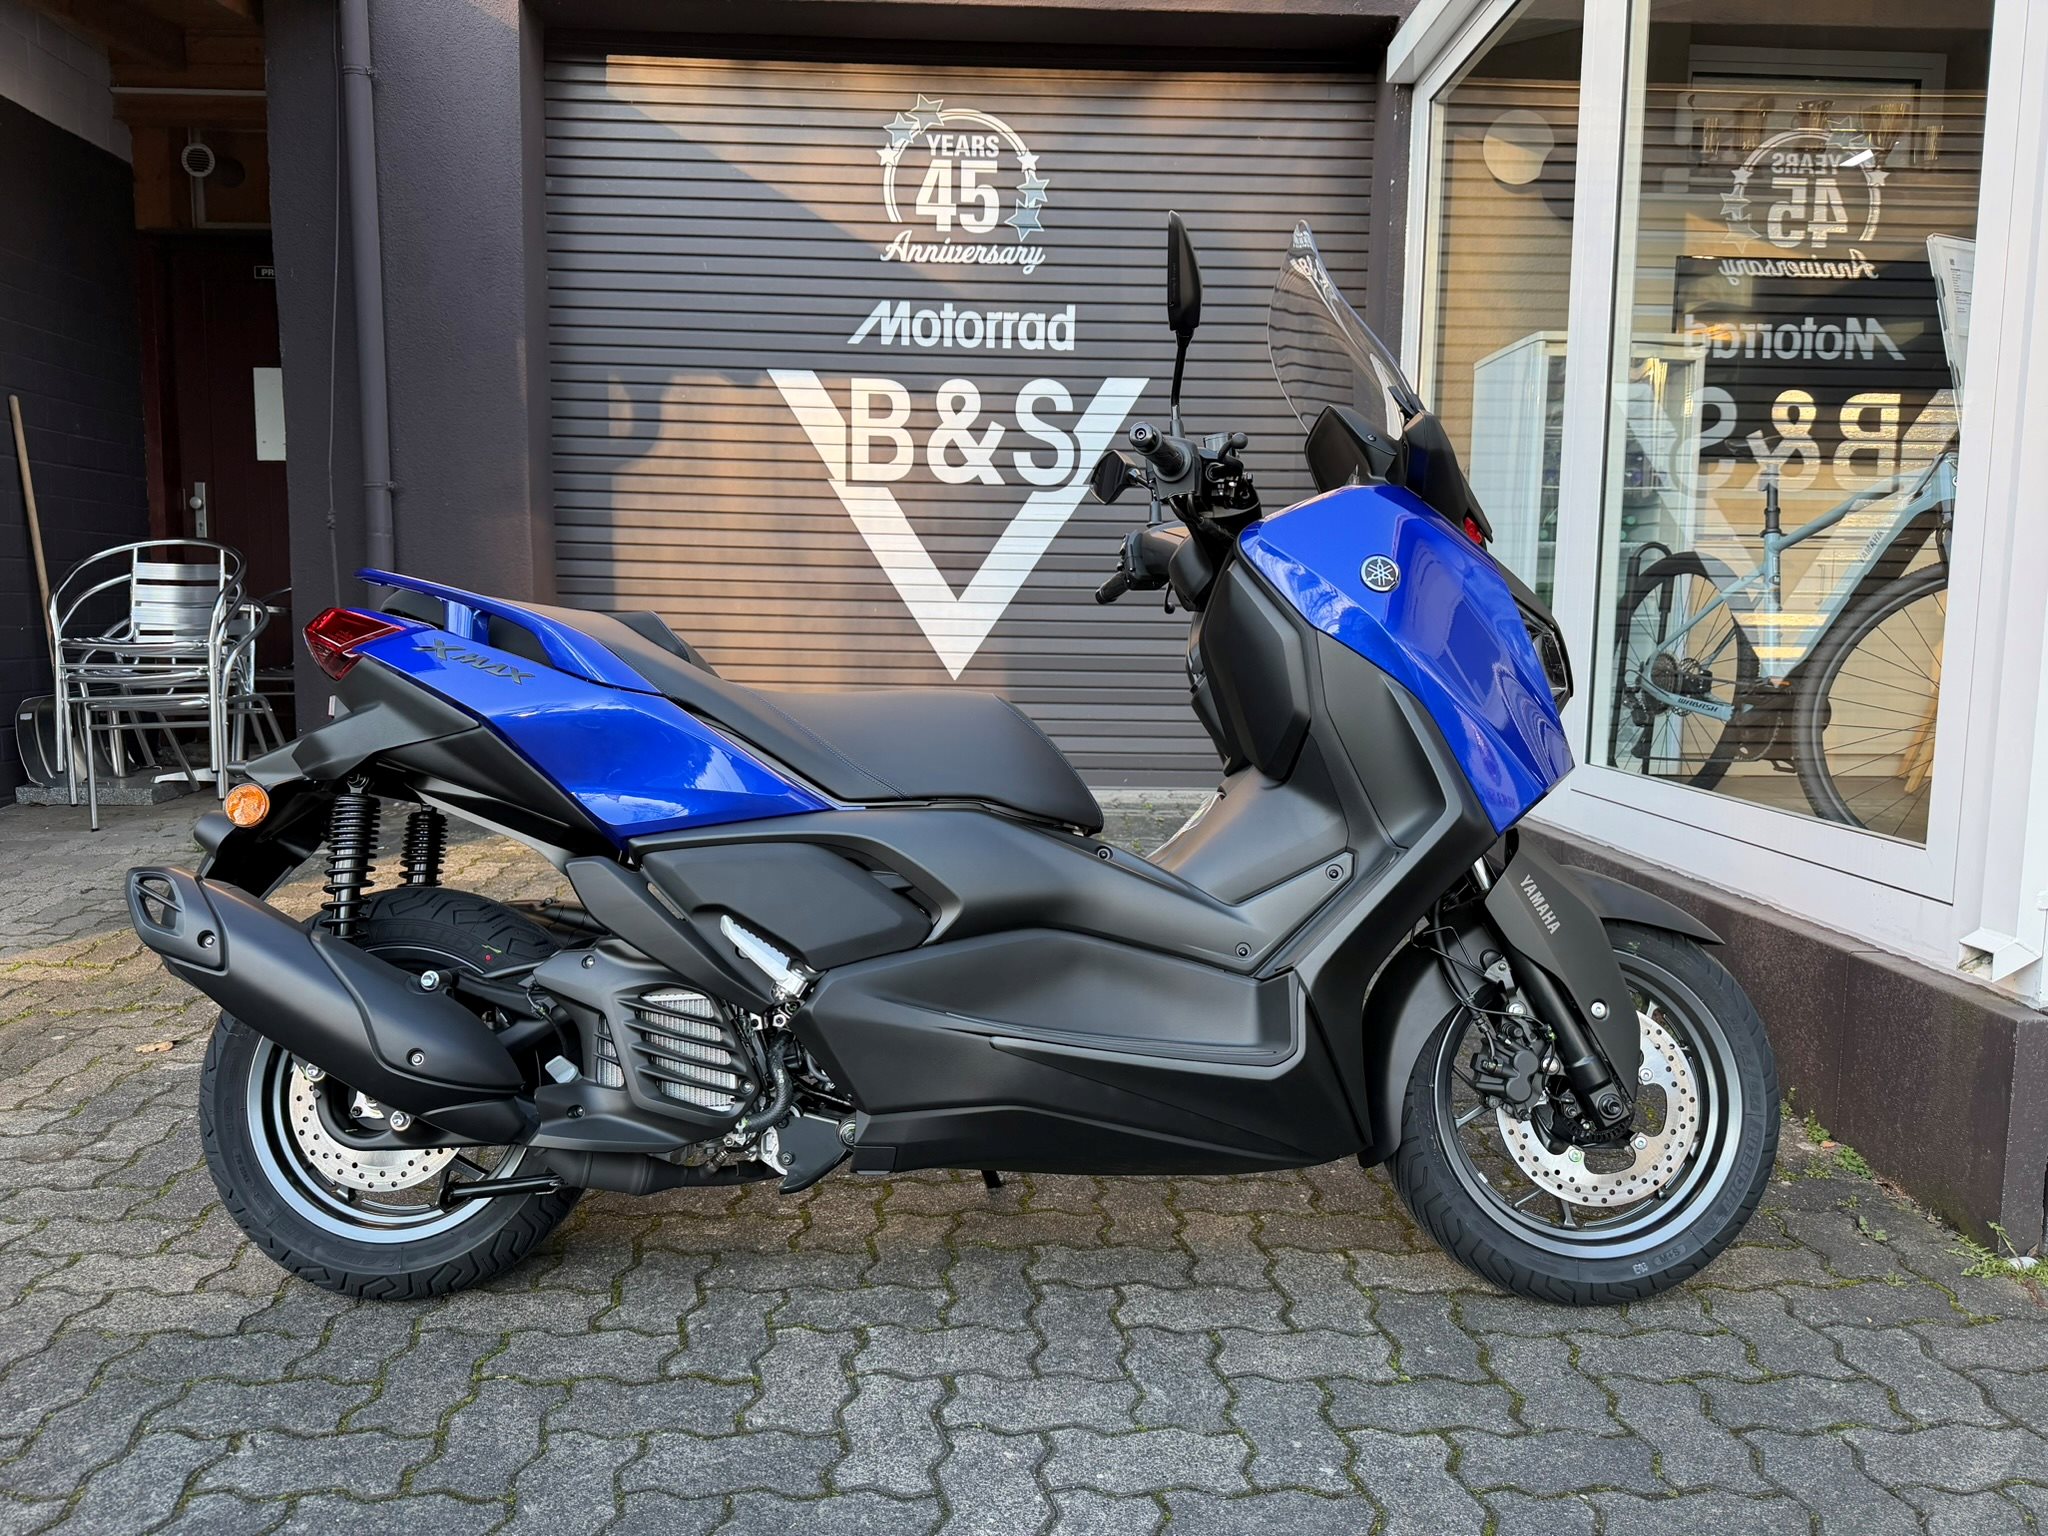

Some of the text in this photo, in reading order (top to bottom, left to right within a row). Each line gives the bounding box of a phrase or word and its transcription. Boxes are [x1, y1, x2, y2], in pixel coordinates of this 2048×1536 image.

[926, 134, 1000, 158] YEARS
[915, 159, 1000, 233] 45
[880, 229, 1046, 275] Anniversary
[847, 300, 1076, 351] Motorrad
[1520, 873, 1561, 935] YAMAHA
[1723, 1122, 1763, 1212] MICHELIN
